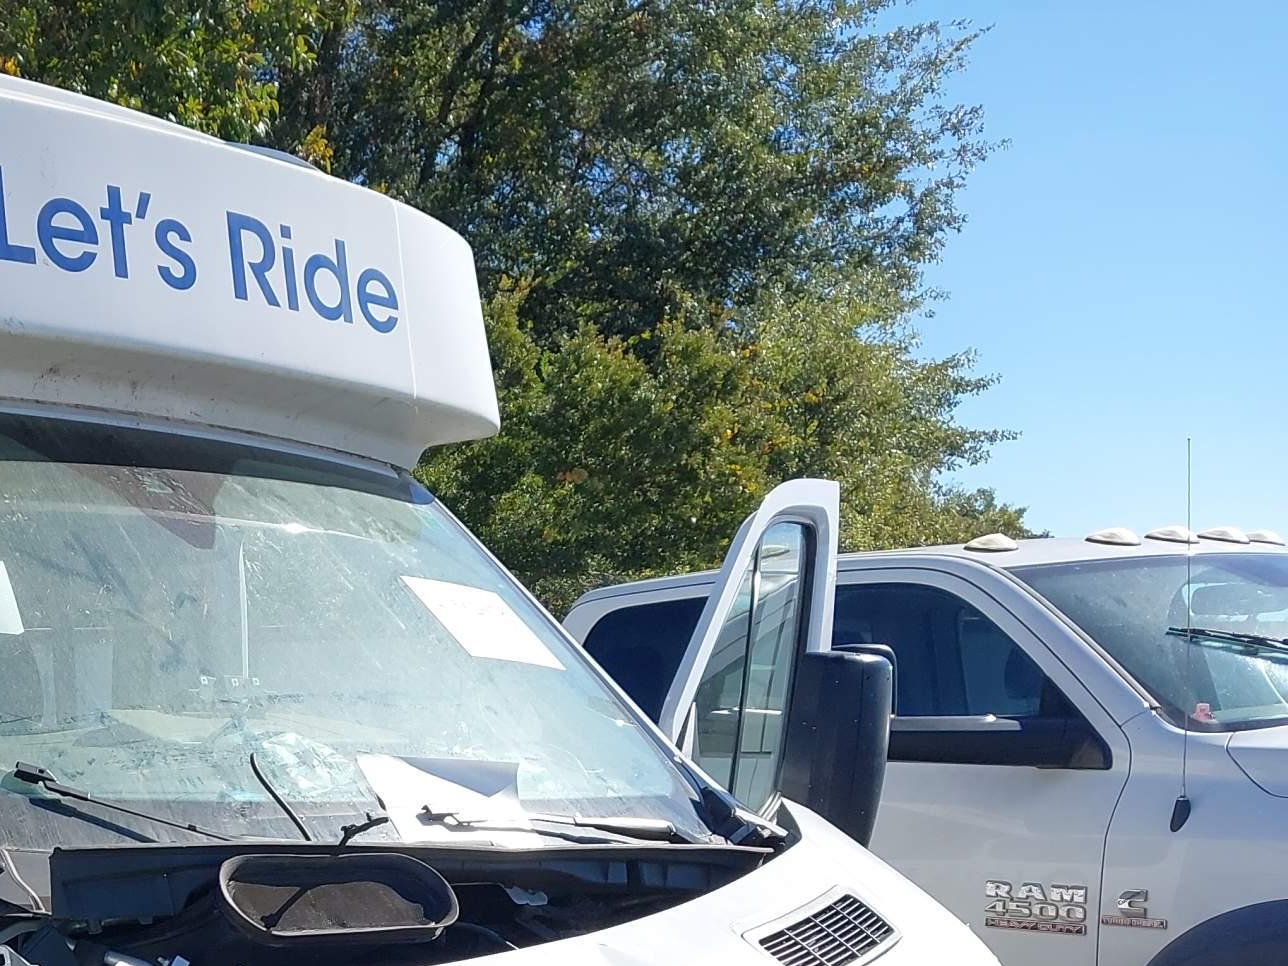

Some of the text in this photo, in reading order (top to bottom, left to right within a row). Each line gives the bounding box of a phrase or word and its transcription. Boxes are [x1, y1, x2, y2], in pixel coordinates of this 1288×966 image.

[225, 210, 399, 334] Ride
[985, 880, 1088, 904] RAM
[984, 899, 1087, 922] 4500
